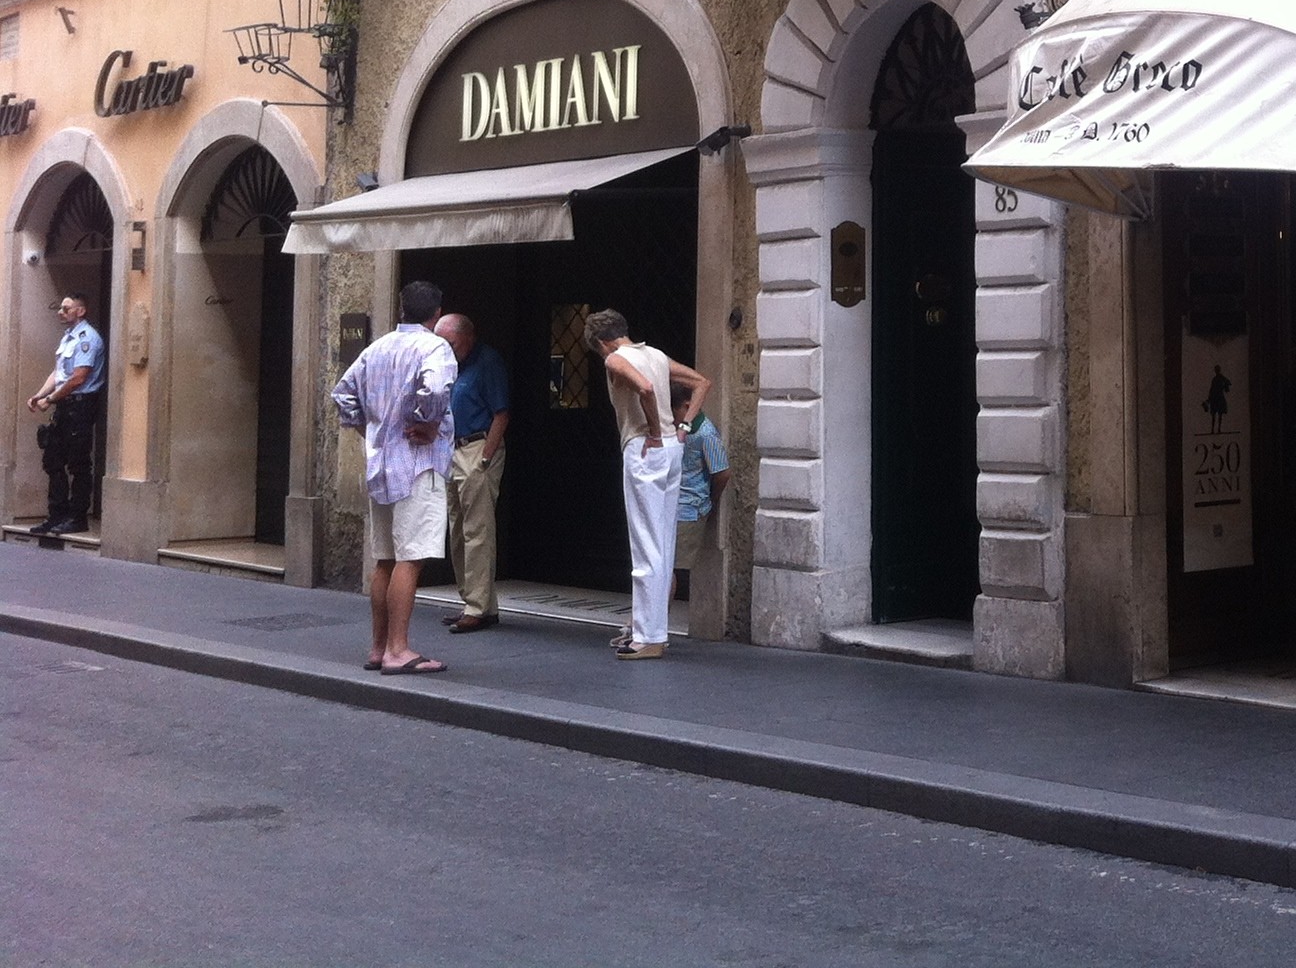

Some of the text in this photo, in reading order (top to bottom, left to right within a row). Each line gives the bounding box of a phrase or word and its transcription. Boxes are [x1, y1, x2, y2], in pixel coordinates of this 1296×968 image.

[94, 49, 195, 118] Cartier
[459, 44, 644, 143] DAMIANI
[1102, 50, 1203, 94] Greco
[0, 92, 36, 136] tier
[1194, 440, 1241, 476] 250
[1194, 476, 1241, 495] ANNI
